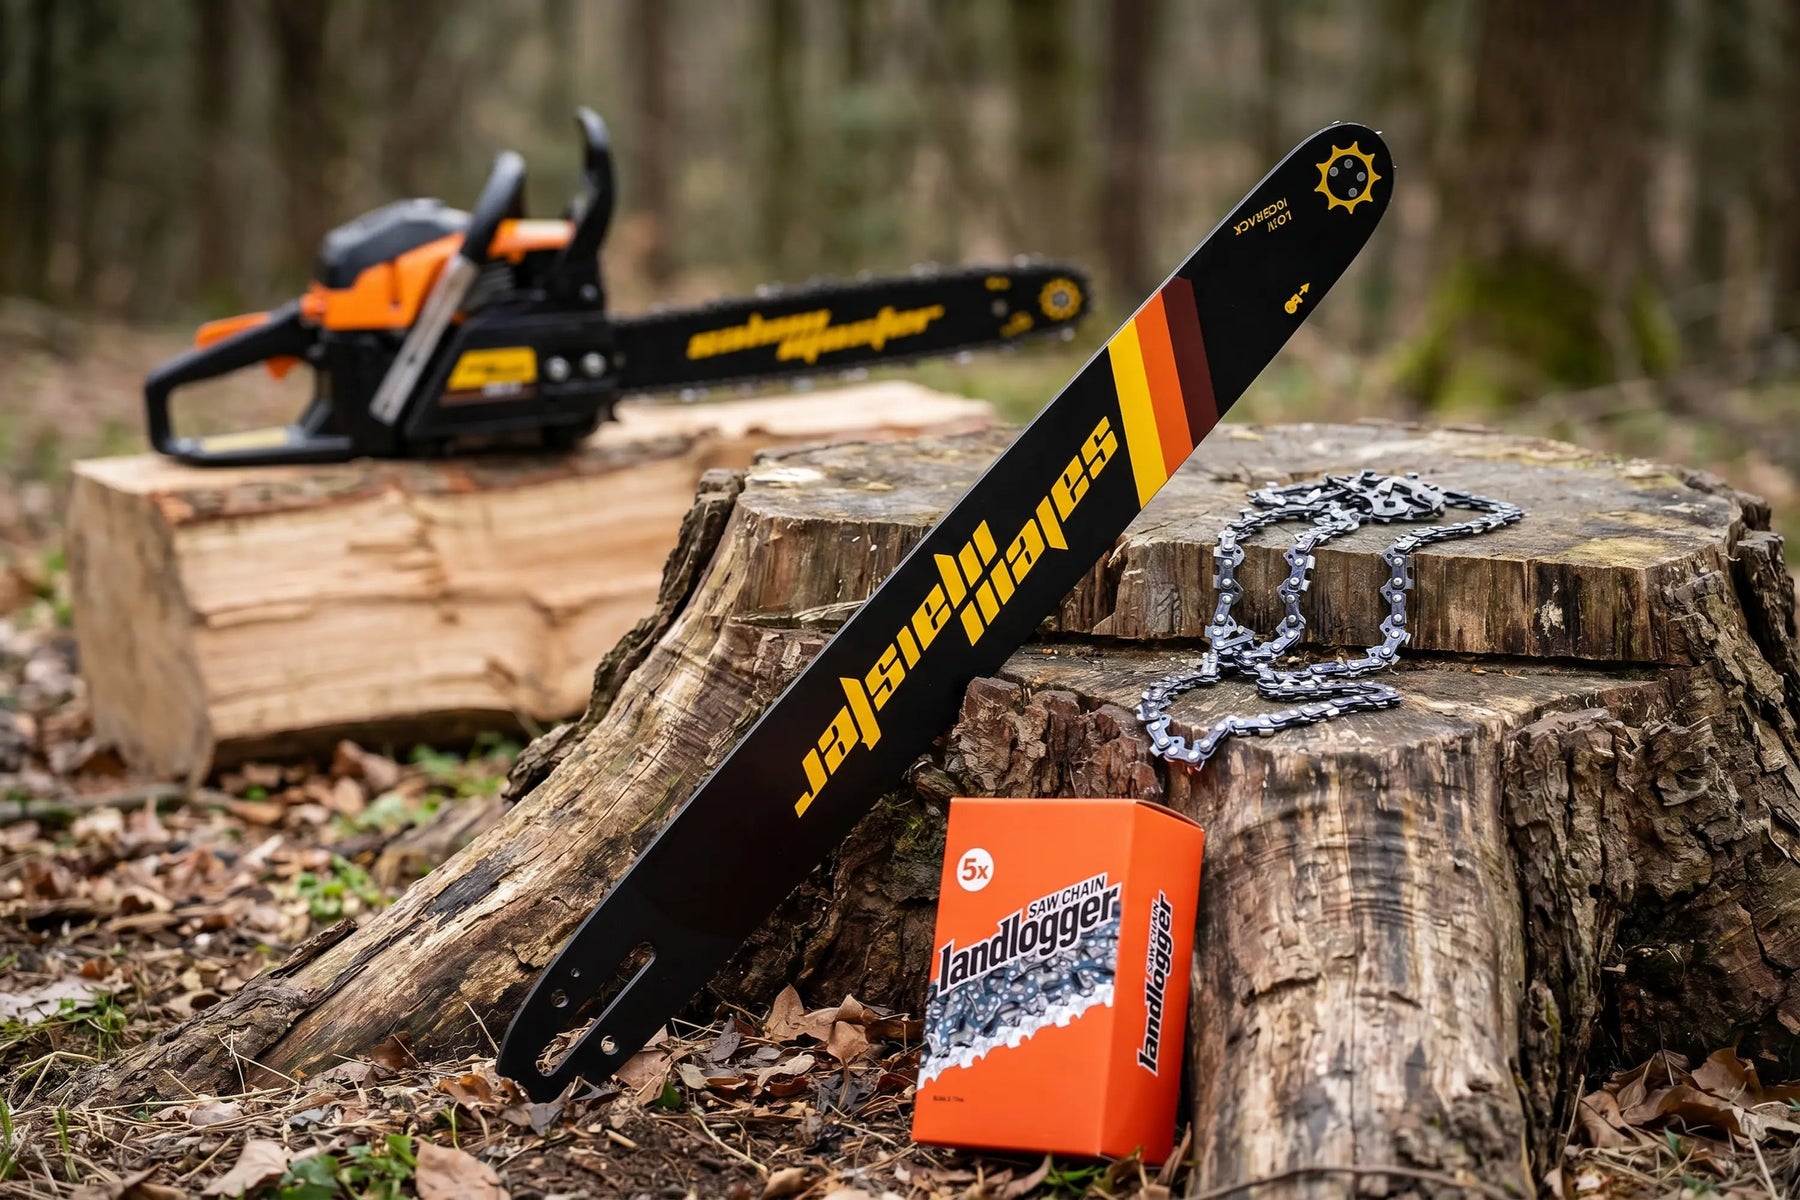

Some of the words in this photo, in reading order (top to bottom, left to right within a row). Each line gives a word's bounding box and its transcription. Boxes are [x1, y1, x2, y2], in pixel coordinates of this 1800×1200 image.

[962, 858, 988, 881] 5x
[1029, 894, 1060, 919] SAW
[1062, 875, 1106, 905] CHAIN
[939, 888, 1121, 993] landlogger
[1138, 893, 1173, 1072] landlogger
